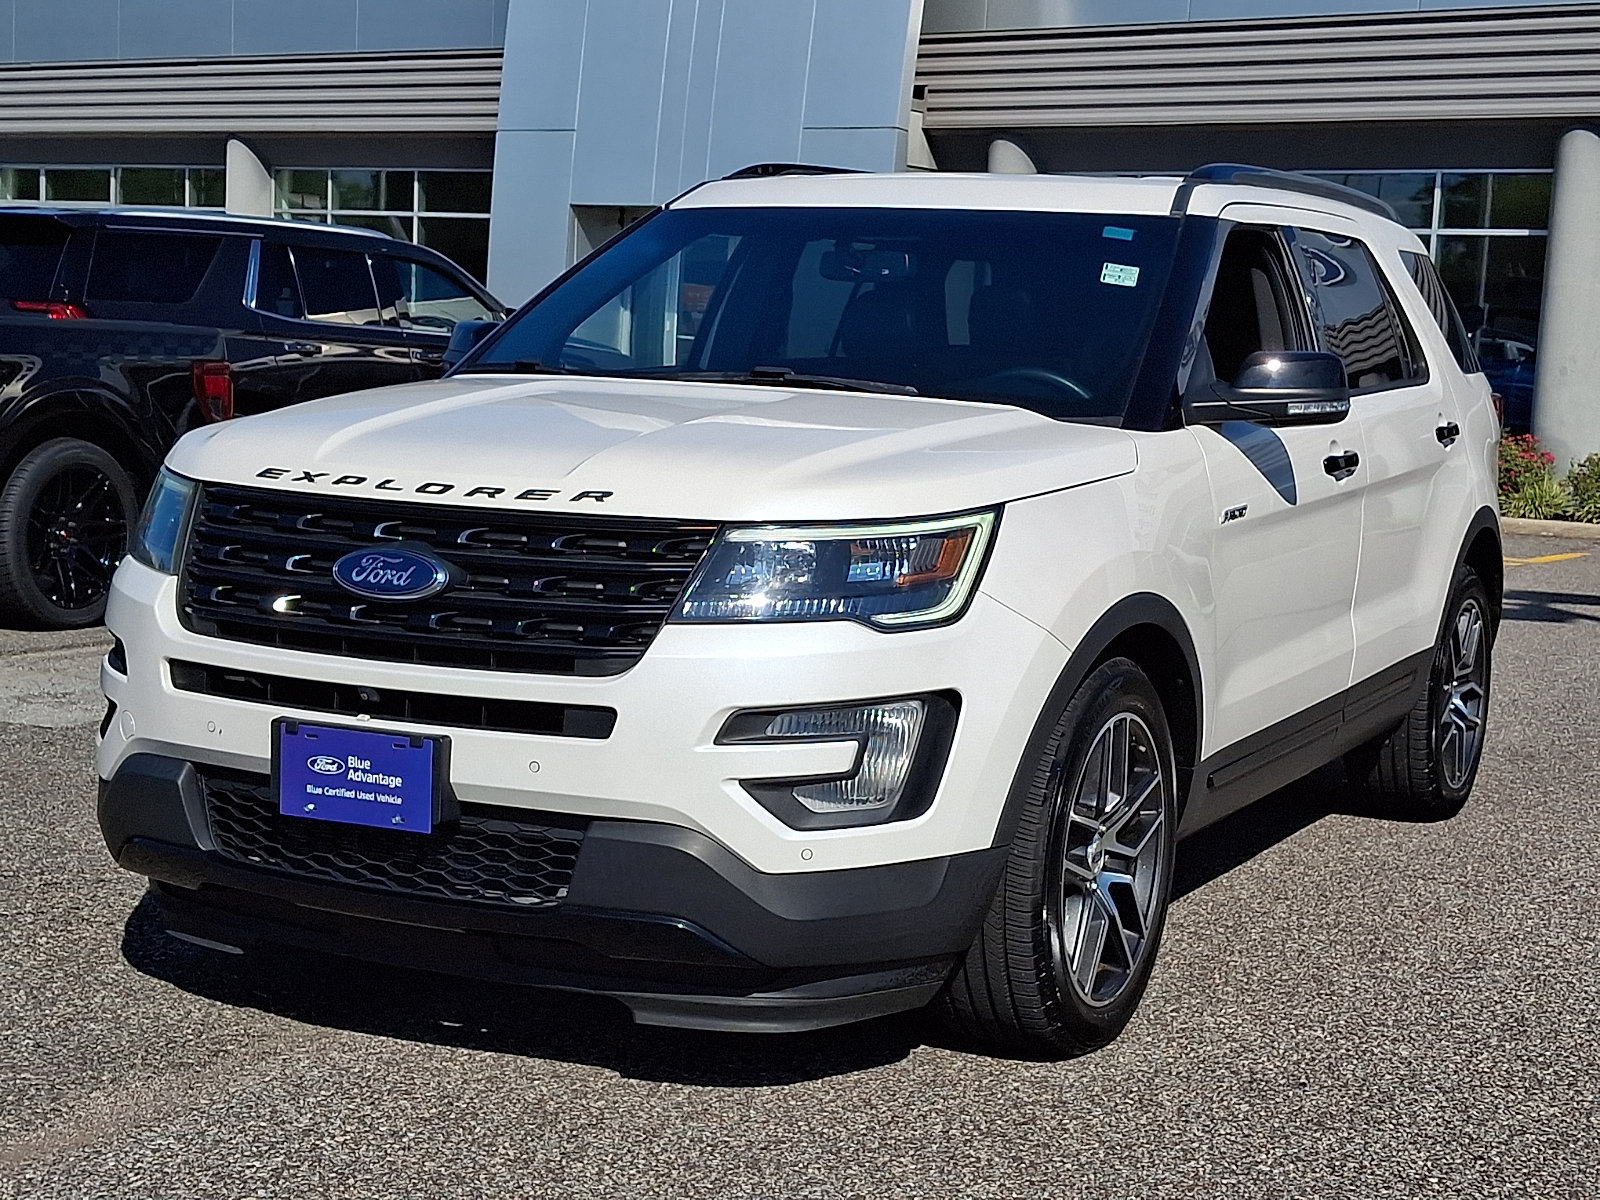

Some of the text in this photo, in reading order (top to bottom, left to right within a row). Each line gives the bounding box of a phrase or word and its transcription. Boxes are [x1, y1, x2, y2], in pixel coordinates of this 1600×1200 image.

[255, 467, 615, 502] EXPLORER
[352, 554, 416, 586] Ford
[347, 756, 371, 769] Blue
[347, 769, 402, 788] Advantage
[306, 784, 402, 805] Blue Certified Used Vehicle
